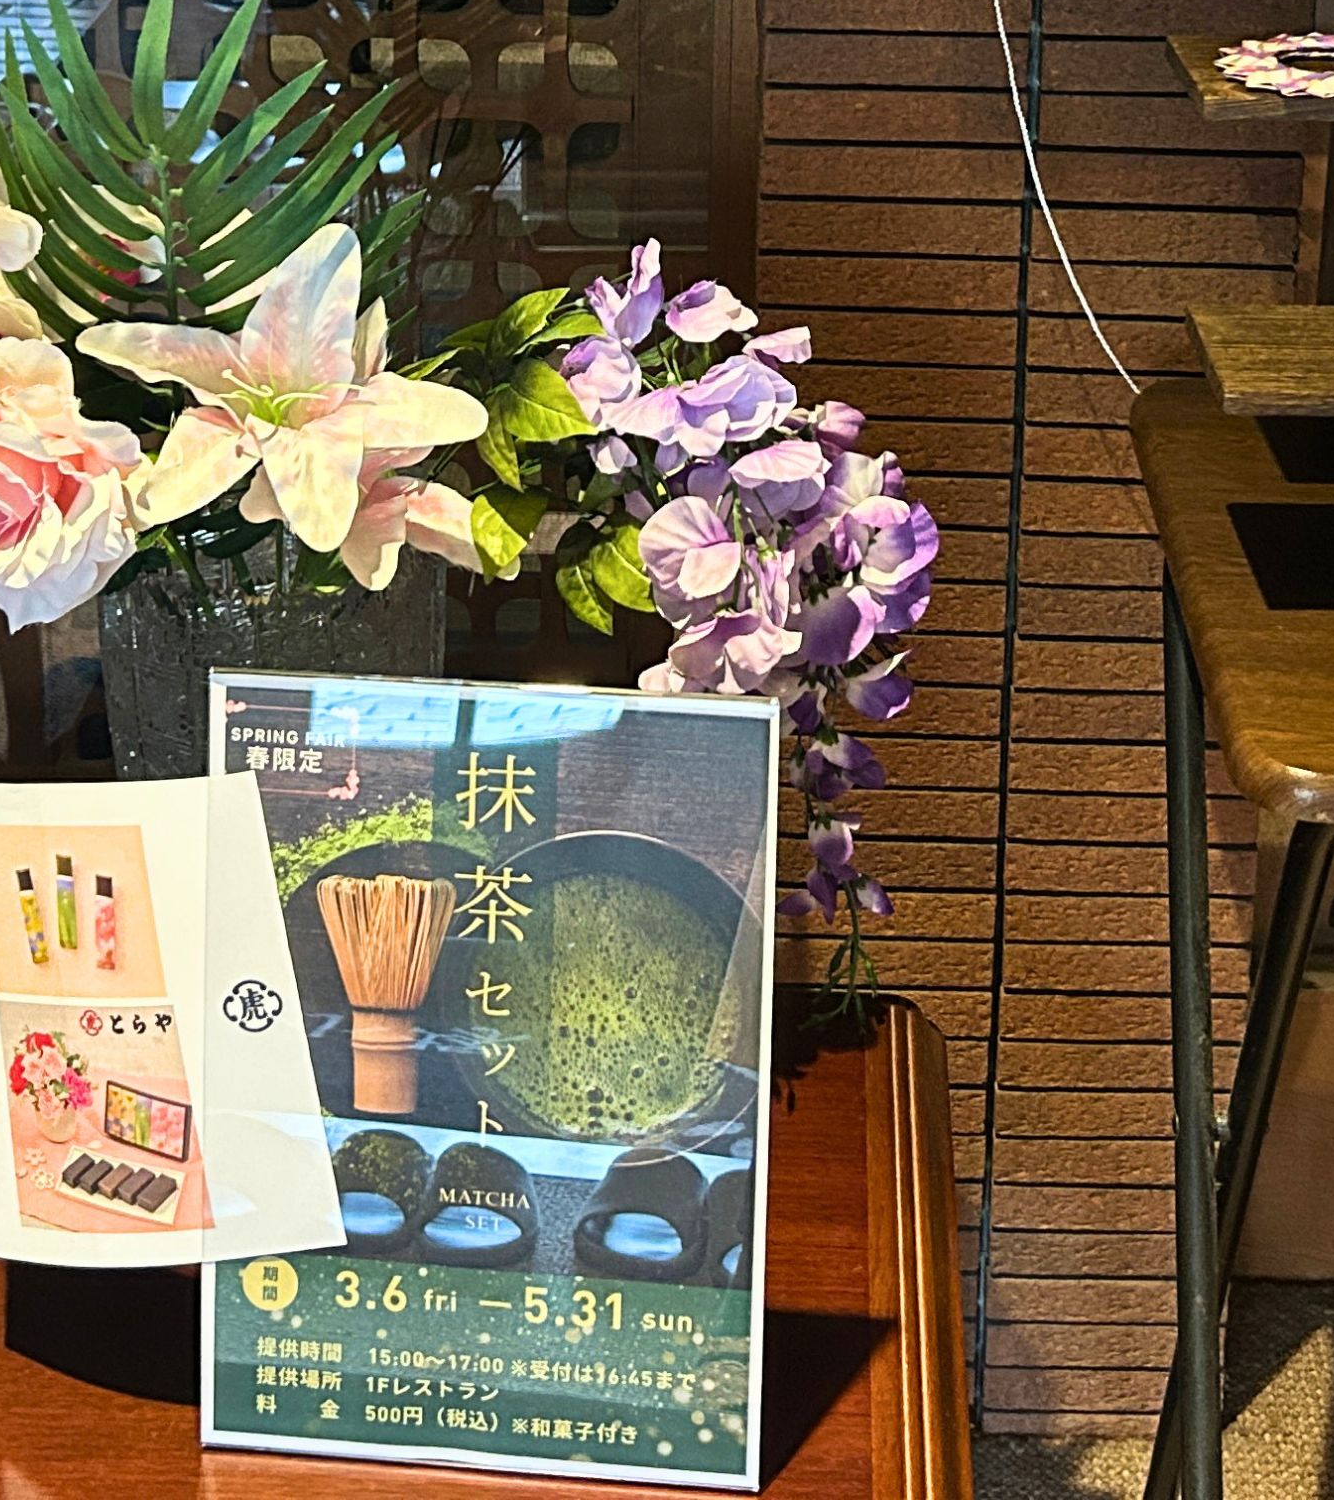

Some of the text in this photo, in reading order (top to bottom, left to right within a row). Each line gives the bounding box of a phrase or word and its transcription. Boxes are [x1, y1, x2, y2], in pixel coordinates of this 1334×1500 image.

[230, 726, 346, 748] SPRING FAIR
[245, 745, 324, 774] 春限定
[453, 751, 537, 1149] 抹茶セット
[110, 1013, 172, 1034] とらや
[439, 1187, 531, 1209] MATCHA
[465, 1215, 501, 1232] SET
[262, 1265, 279, 1302] 期間
[335, 1269, 408, 1313] 3.6
[424, 1288, 458, 1313] fri
[524, 1285, 623, 1331] 5.31
[642, 1312, 693, 1334] sun
[256, 1336, 343, 1363] 提供時間
[256, 1365, 499, 1403] 提供場所 1Fレストラン
[256, 1393, 277, 1415] 料
[319, 1398, 341, 1420] 金
